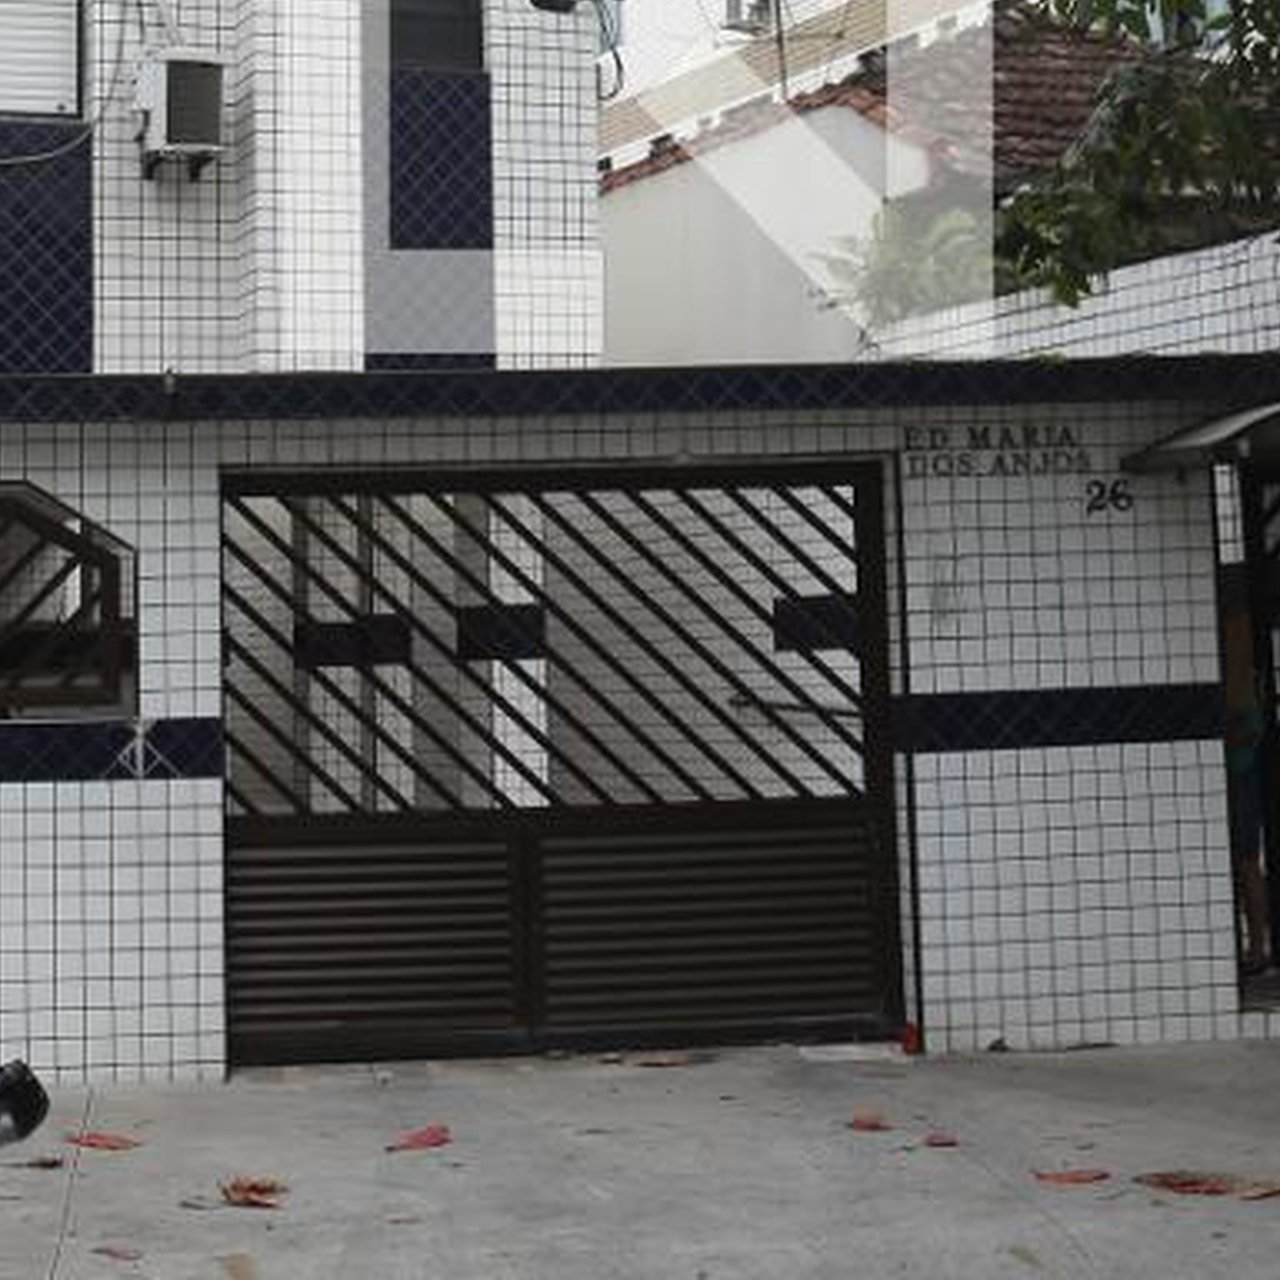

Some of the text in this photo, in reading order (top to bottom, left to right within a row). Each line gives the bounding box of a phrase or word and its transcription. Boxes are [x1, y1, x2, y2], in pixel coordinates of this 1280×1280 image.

[903, 426, 1077, 451] ED MARIA
[907, 452, 972, 478] DOS
[1085, 479, 1134, 516] 26
